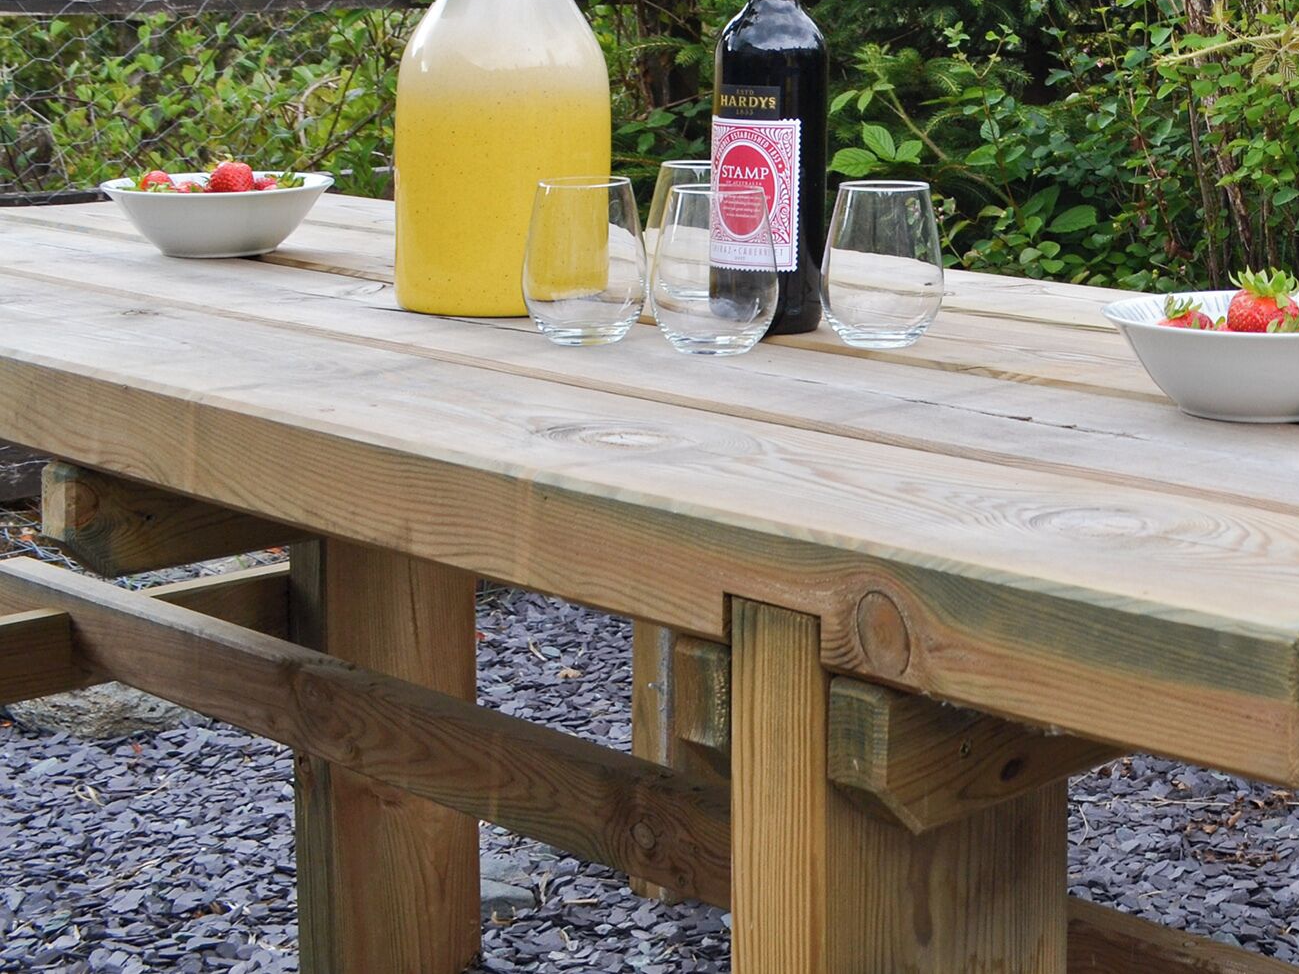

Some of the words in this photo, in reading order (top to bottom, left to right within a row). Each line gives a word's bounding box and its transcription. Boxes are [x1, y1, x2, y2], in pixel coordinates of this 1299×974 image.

[720, 95, 776, 109] HARDYS
[730, 131, 769, 148] ESTABLISHED
[721, 165, 769, 180] STAMP
